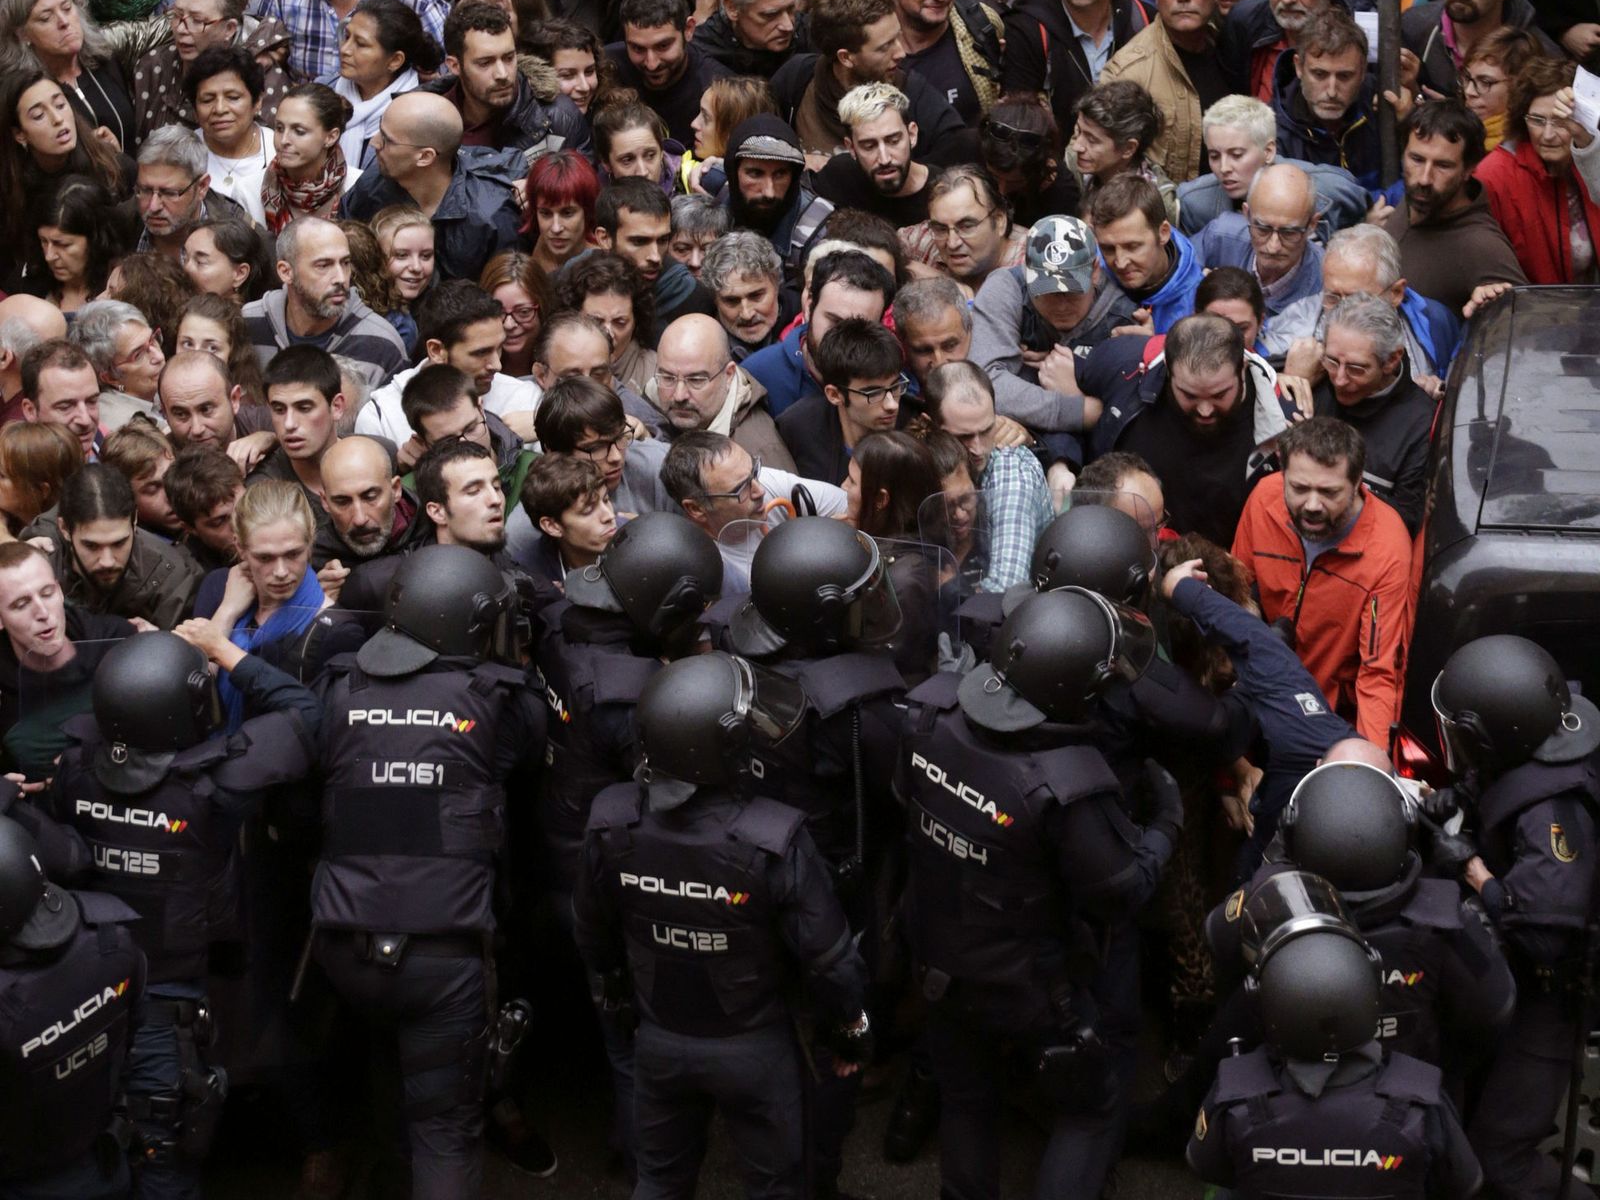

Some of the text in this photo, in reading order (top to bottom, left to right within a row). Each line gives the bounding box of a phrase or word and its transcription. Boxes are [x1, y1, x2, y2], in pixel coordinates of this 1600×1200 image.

[349, 709, 458, 729] POLICIA
[372, 761, 444, 785] UC161
[912, 752, 997, 820] POLICIA
[76, 800, 171, 829] POLICIA
[921, 812, 988, 866] UC164
[94, 845, 160, 875] UC125
[620, 872, 731, 900] POLICIA
[652, 924, 728, 951] UC122
[22, 987, 118, 1058] POLICIA
[55, 1033, 108, 1080] UC13
[1252, 1148, 1383, 1167] POLICIA
